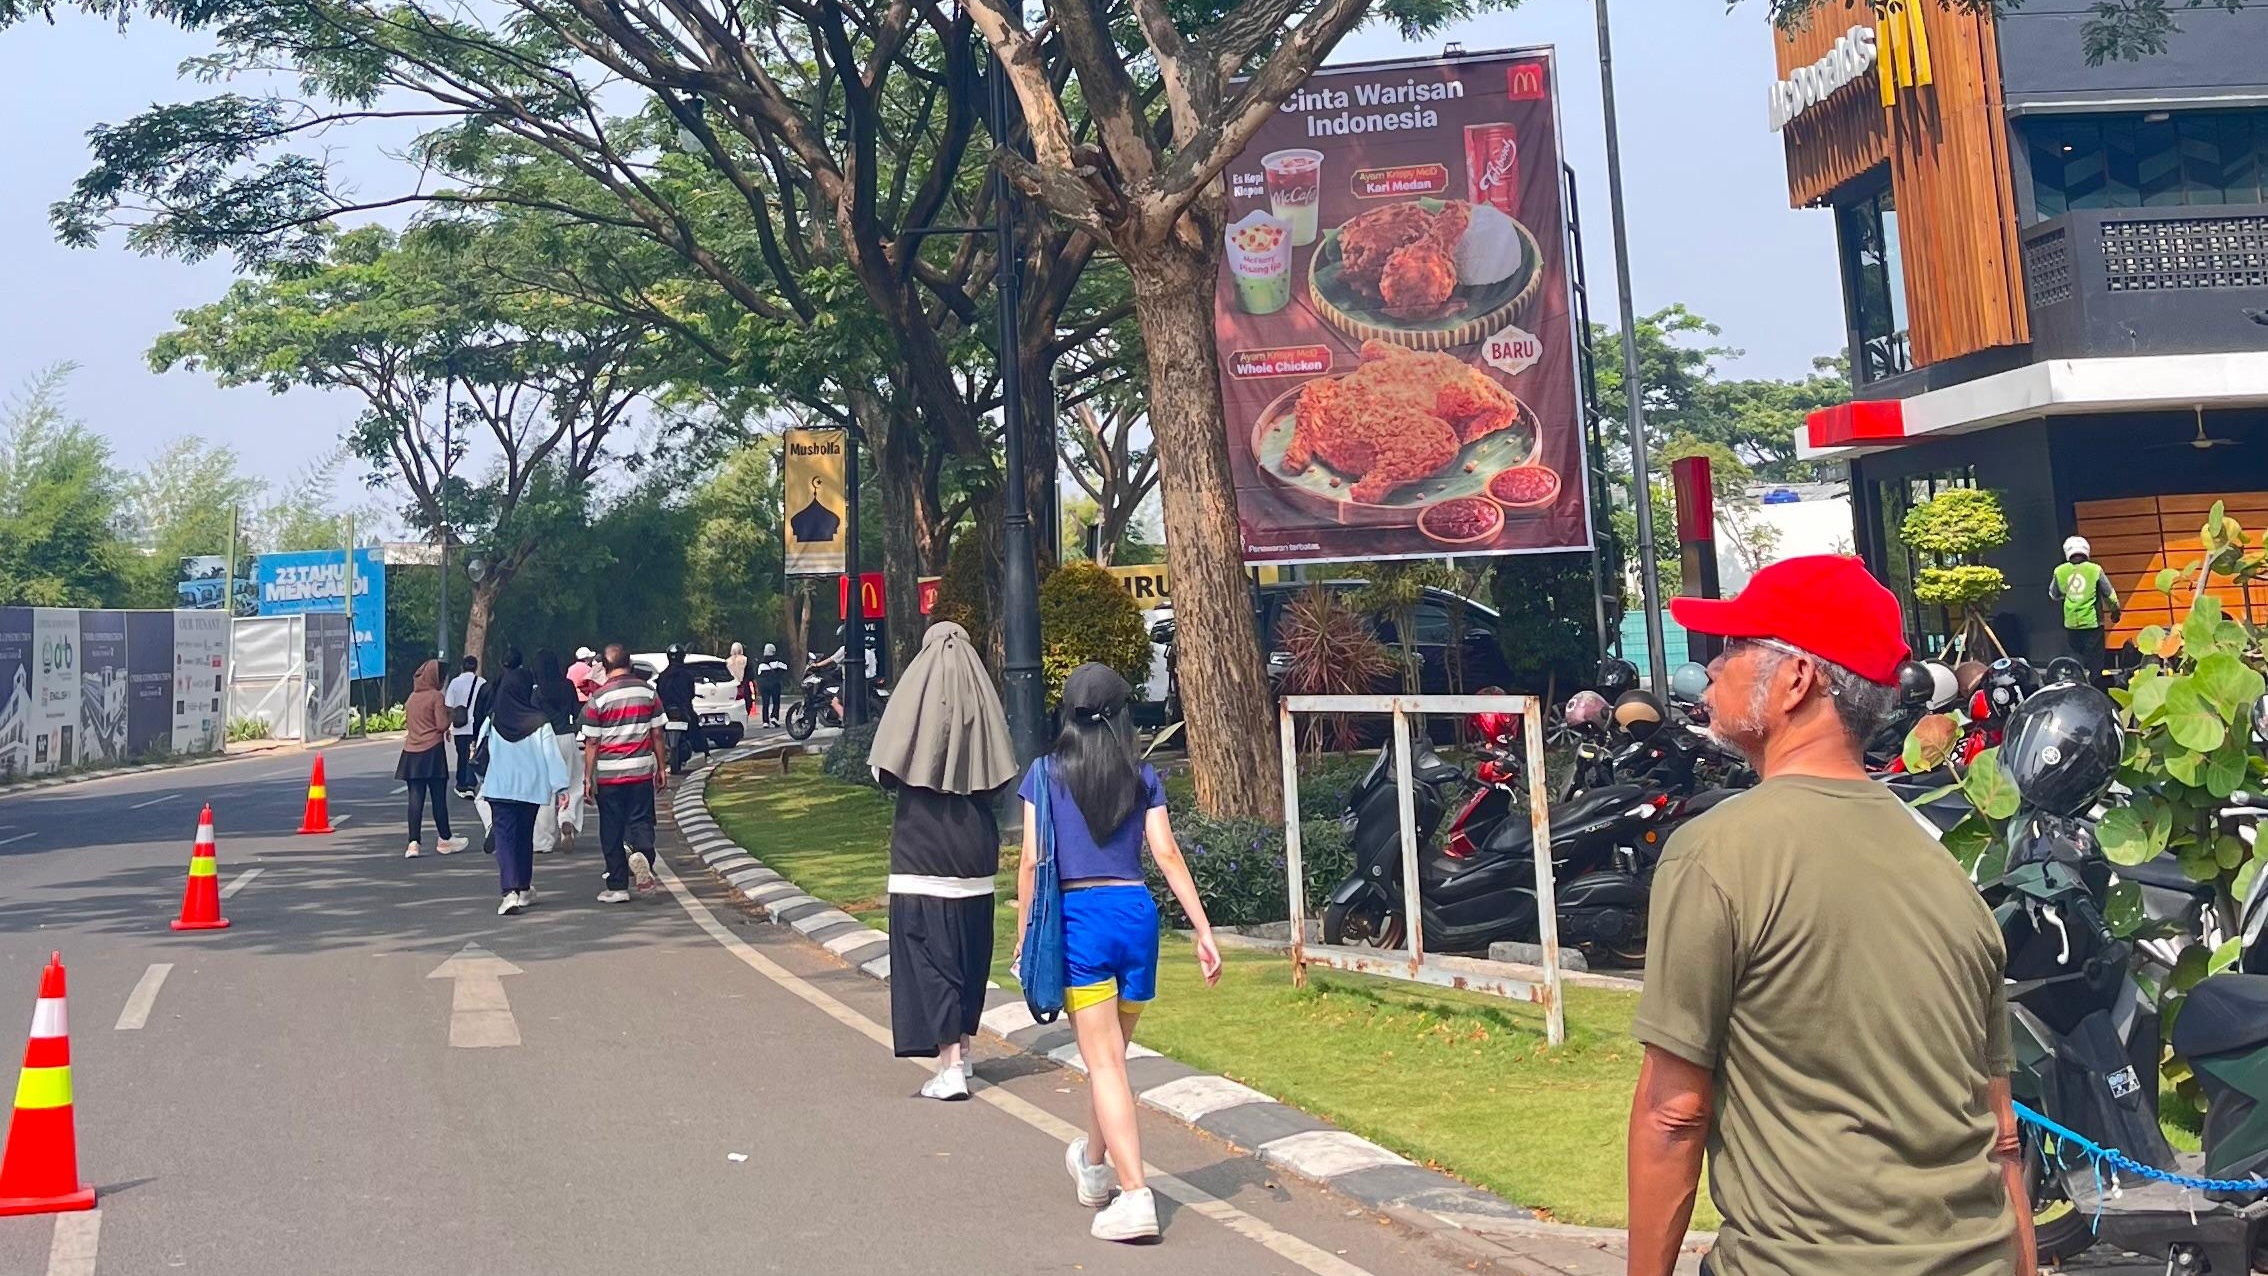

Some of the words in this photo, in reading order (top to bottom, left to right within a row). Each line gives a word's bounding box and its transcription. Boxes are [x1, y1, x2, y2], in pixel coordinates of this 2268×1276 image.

[1354, 78, 1464, 107] Warisan
[1307, 104, 1438, 137] Indonesia
[1232, 173, 1243, 185] Es
[1244, 171, 1264, 185] Kopi
[1360, 172, 1385, 183] Ayam
[1366, 181, 1390, 194] Kari
[1392, 179, 1432, 191] Medan
[1240, 353, 1266, 363] Ayam
[1492, 341, 1534, 360] BARU
[1236, 362, 1273, 375] Whole
[1275, 360, 1323, 373] Chicken
[790, 442, 841, 456] Musholla
[275, 567, 297, 585] 23
